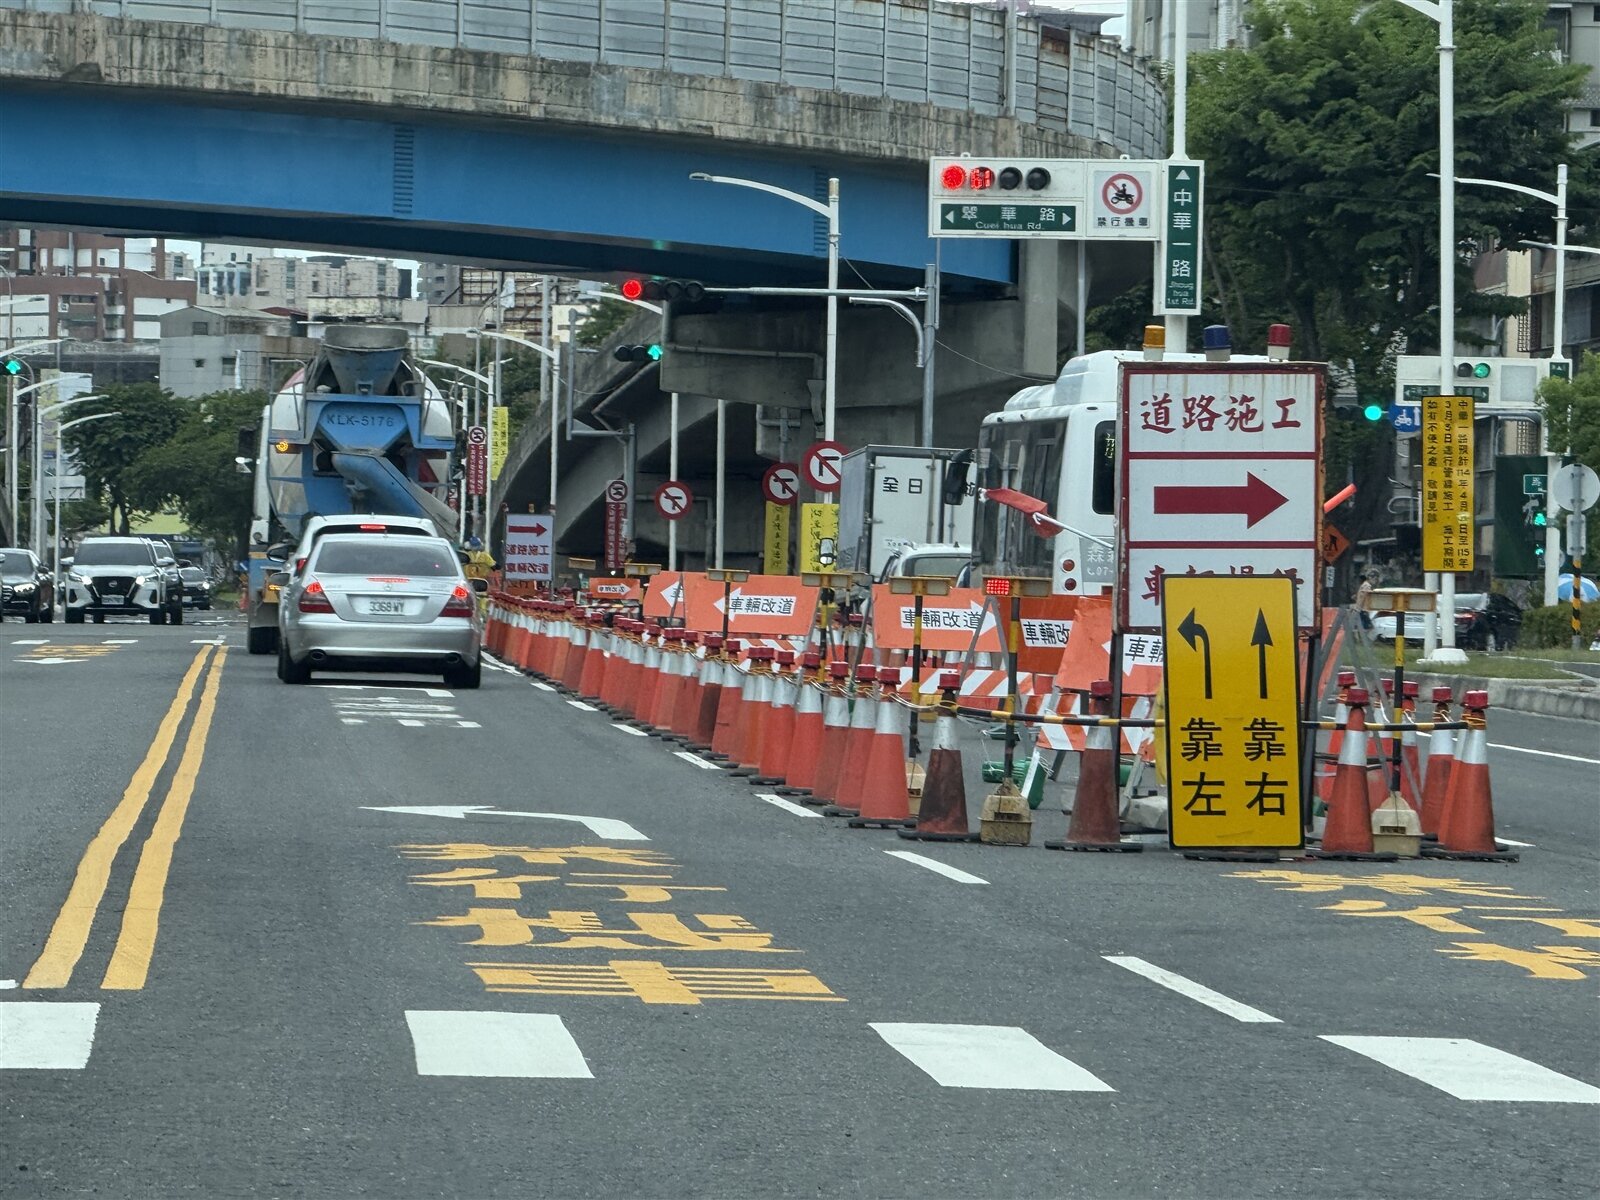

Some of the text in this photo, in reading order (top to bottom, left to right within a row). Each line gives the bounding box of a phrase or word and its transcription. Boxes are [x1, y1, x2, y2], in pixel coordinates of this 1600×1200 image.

[961, 206, 1055, 222] 翠華路
[1003, 222, 1023, 230] hua
[1172, 188, 1192, 278] 中華一路
[1140, 393, 1301, 434] 道路施工
[729, 596, 794, 615] 車輛改道
[1180, 717, 1227, 817] 靠左
[1242, 717, 1289, 817] 靠右
